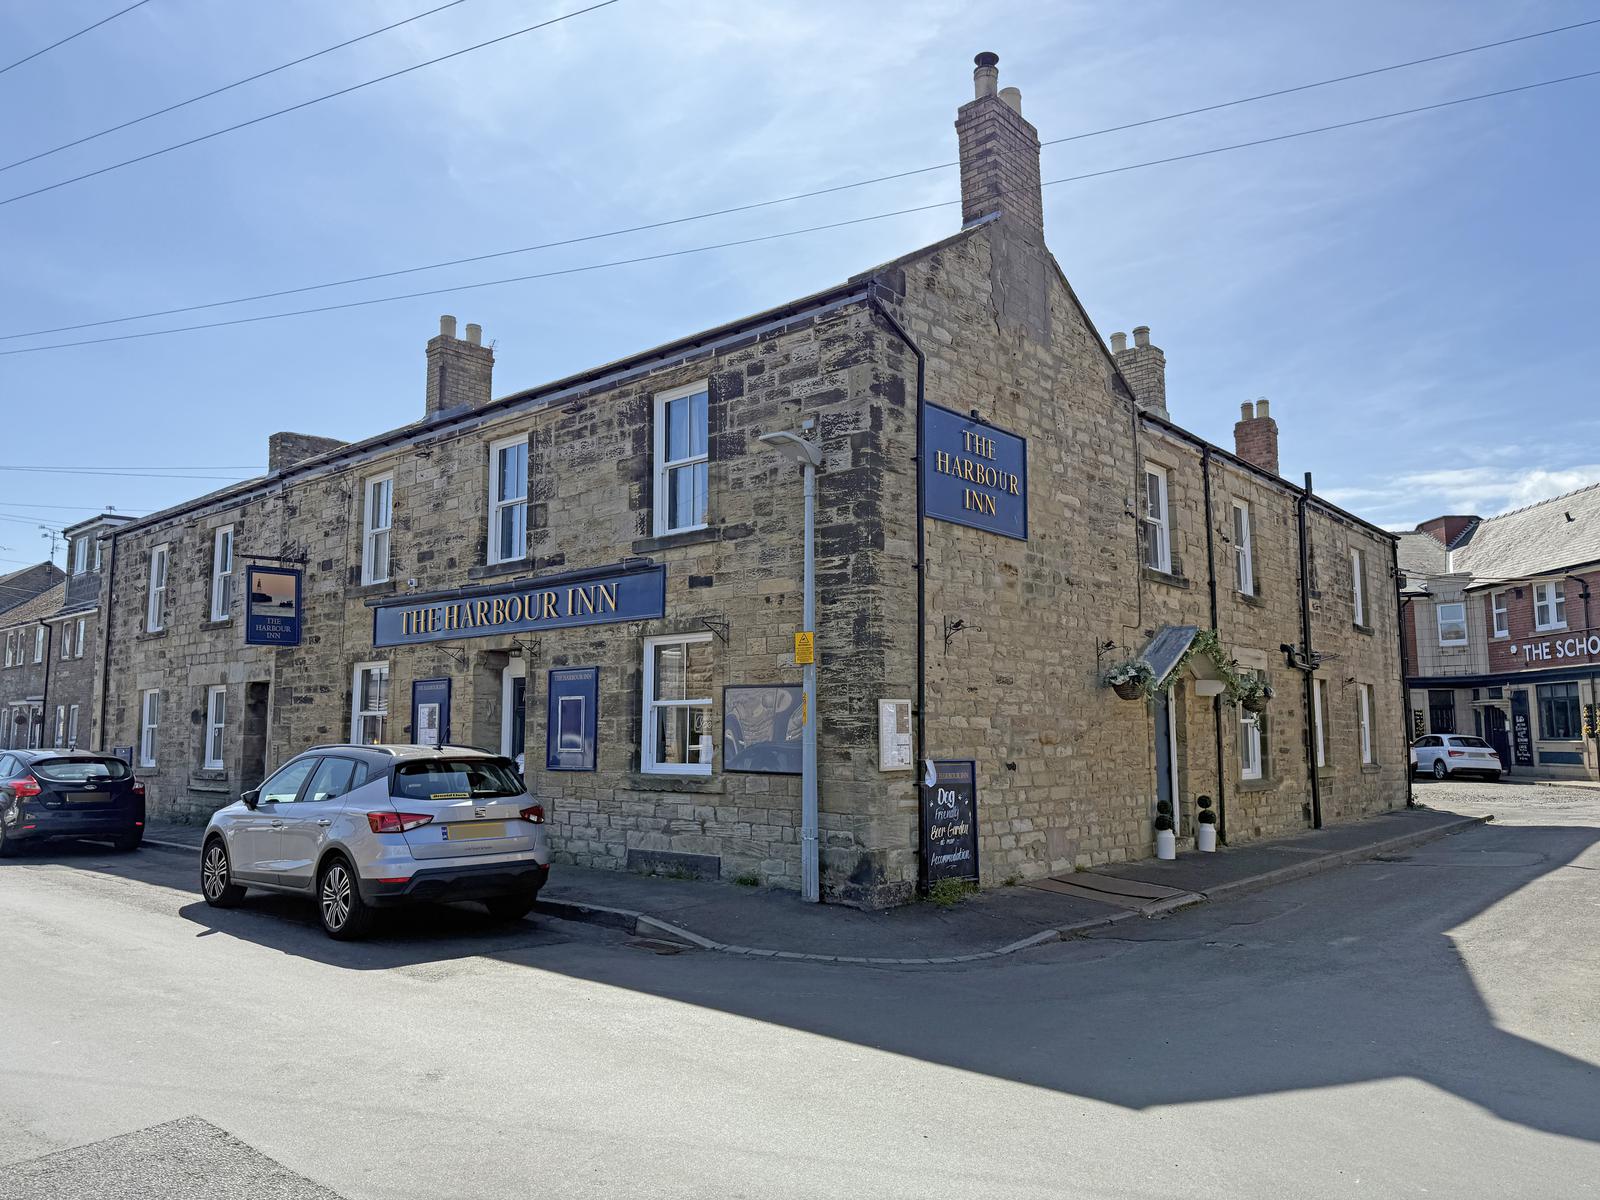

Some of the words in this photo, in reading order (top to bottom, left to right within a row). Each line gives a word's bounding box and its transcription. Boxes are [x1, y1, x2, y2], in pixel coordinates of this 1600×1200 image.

[962, 429, 997, 460] THE
[936, 450, 1020, 495] HARBOUR
[965, 488, 997, 516] INN
[267, 617, 281, 625] THE
[400, 607, 442, 635] THE
[444, 591, 560, 630] HARBOUR
[566, 582, 619, 616] INN
[255, 624, 292, 633] HARBOUR
[1523, 641, 1552, 661] THE
[1555, 635, 1600, 658] SCHO
[937, 787, 956, 809] Dog
[930, 825, 946, 840] Beer
